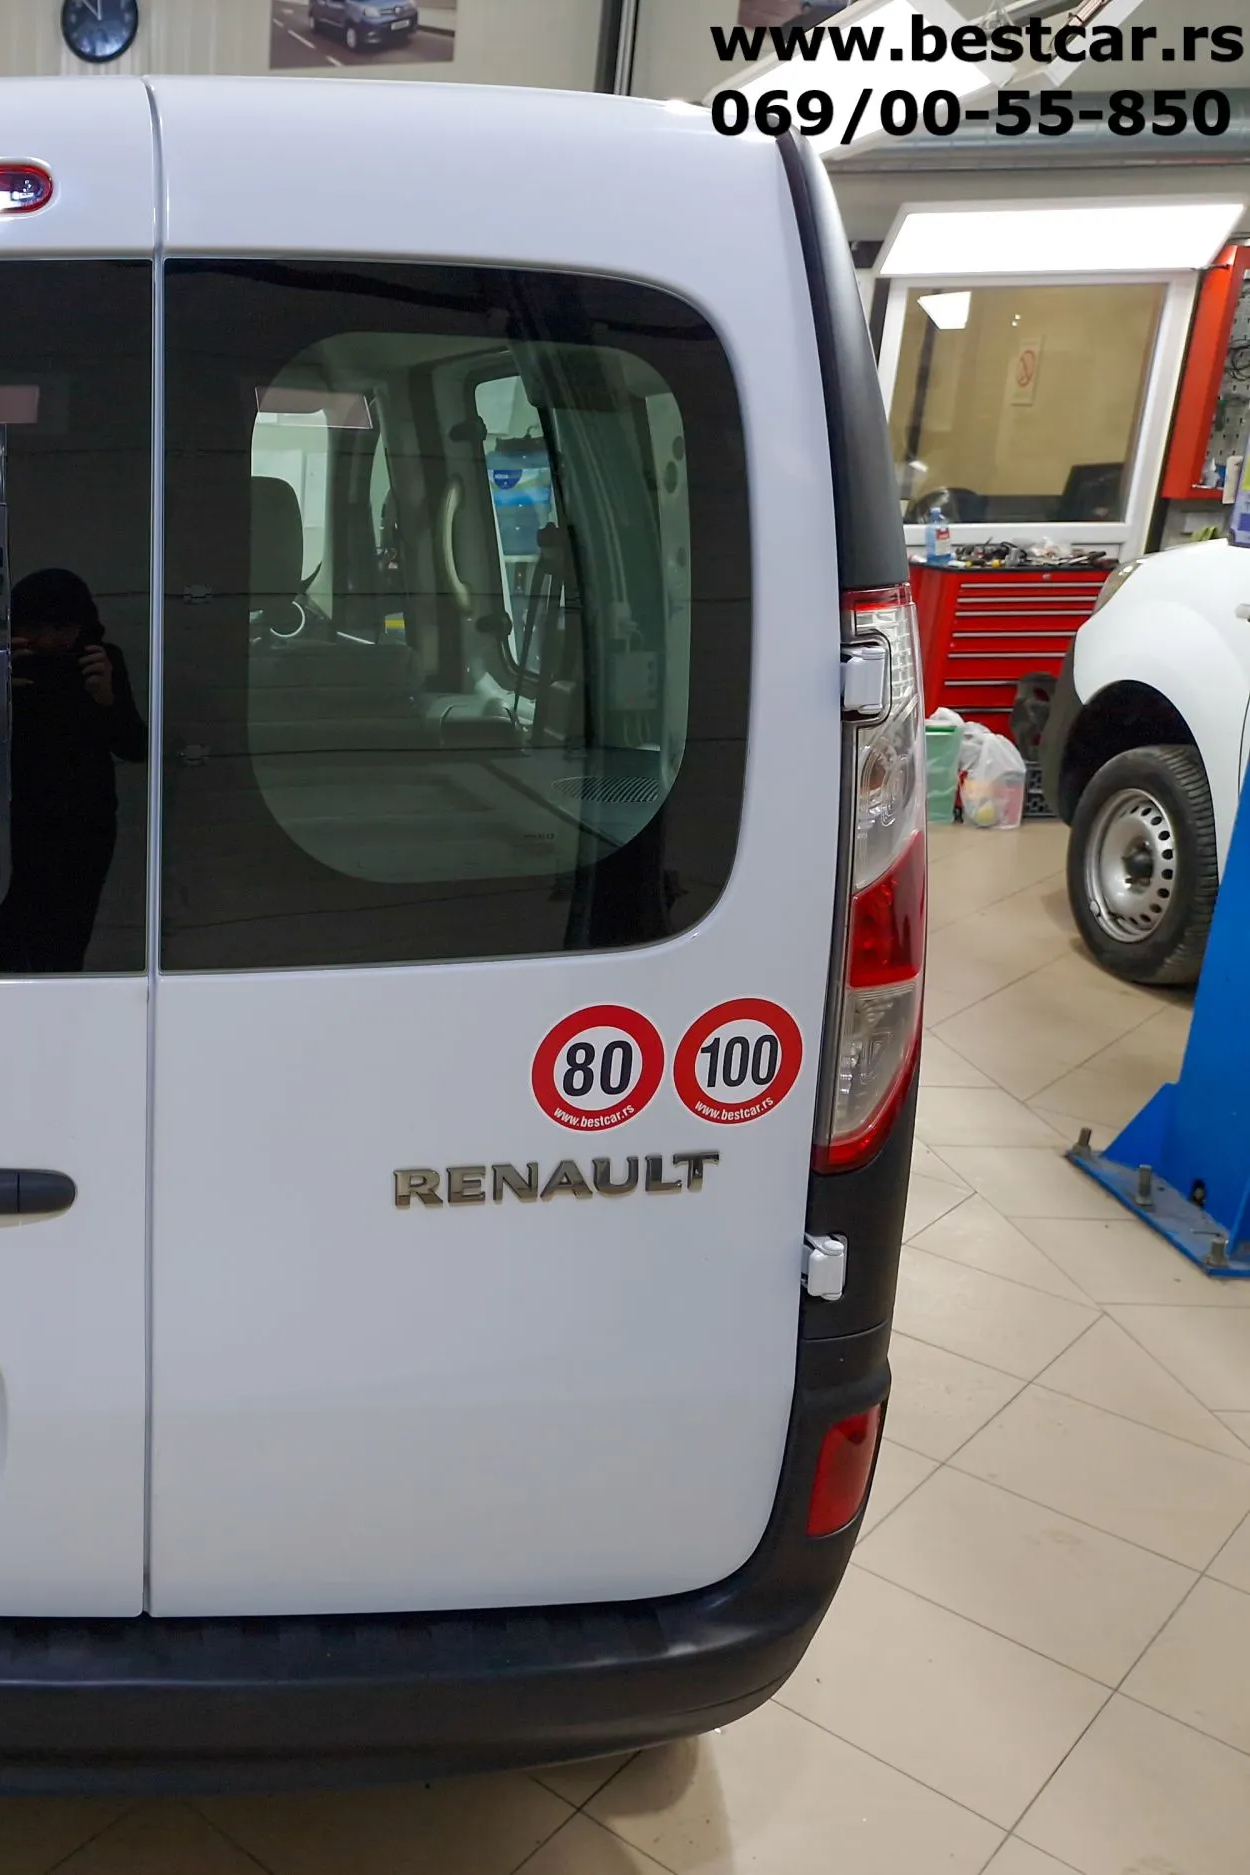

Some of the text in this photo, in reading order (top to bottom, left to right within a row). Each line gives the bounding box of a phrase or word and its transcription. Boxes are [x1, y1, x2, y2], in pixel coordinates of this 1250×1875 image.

[562, 1040, 633, 1097] 80
[700, 1034, 779, 1088] 100
[554, 1104, 635, 1128] www.bestcar.rs
[695, 1096, 774, 1121] www.bestcar.rs
[393, 1150, 720, 1209] RENAULT
